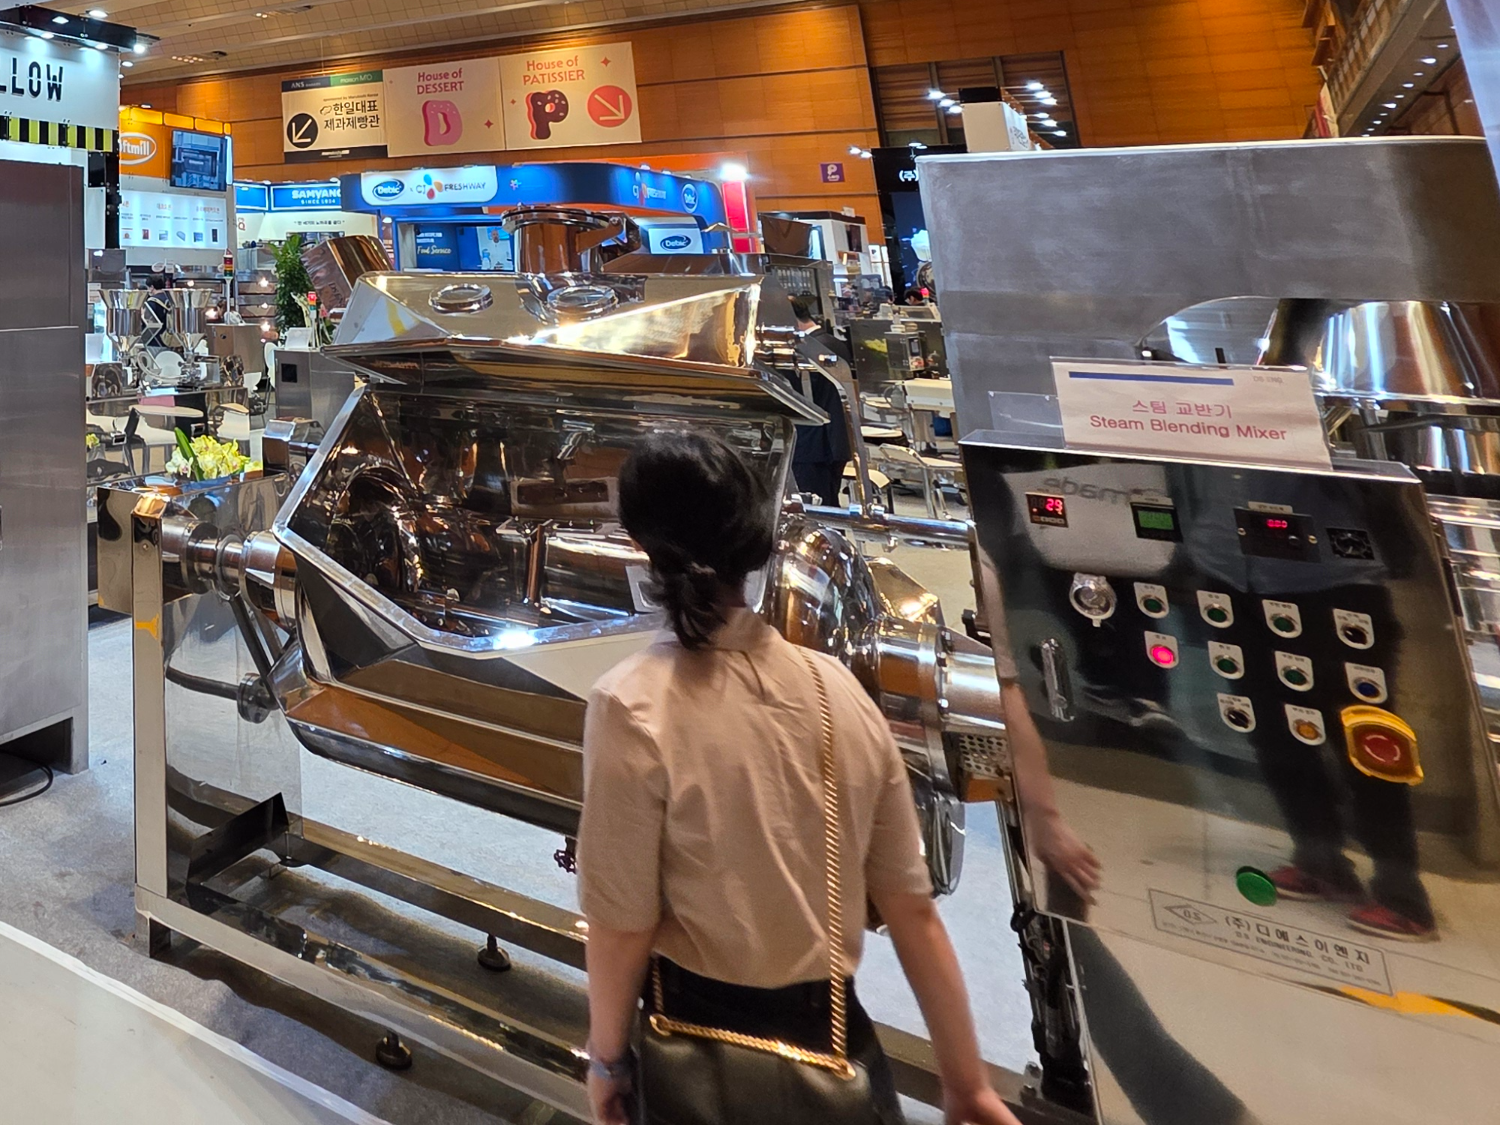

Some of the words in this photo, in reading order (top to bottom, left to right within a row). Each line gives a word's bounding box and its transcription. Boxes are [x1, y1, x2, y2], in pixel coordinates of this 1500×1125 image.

[526, 59, 563, 71] House
[566, 55, 579, 67] of
[417, 71, 449, 82] House
[451, 68, 463, 78] of
[522, 69, 585, 86] PATISSIER
[416, 80, 464, 95] DESSERT
[333, 100, 378, 115] 한일대표
[525, 89, 569, 140] P
[324, 114, 380, 131] 제과제빵관
[421, 99, 463, 146] D
[119, 140, 150, 155] ftmill
[377, 184, 402, 195] Debic
[415, 184, 427, 194] CJ
[444, 182, 486, 191] FRESHWAY
[1132, 400, 1167, 414] 스팀
[1176, 402, 1232, 419] 교반기
[1090, 415, 1144, 431] Steam
[1151, 419, 1230, 438] Blending
[1236, 425, 1287, 441] Mixer
